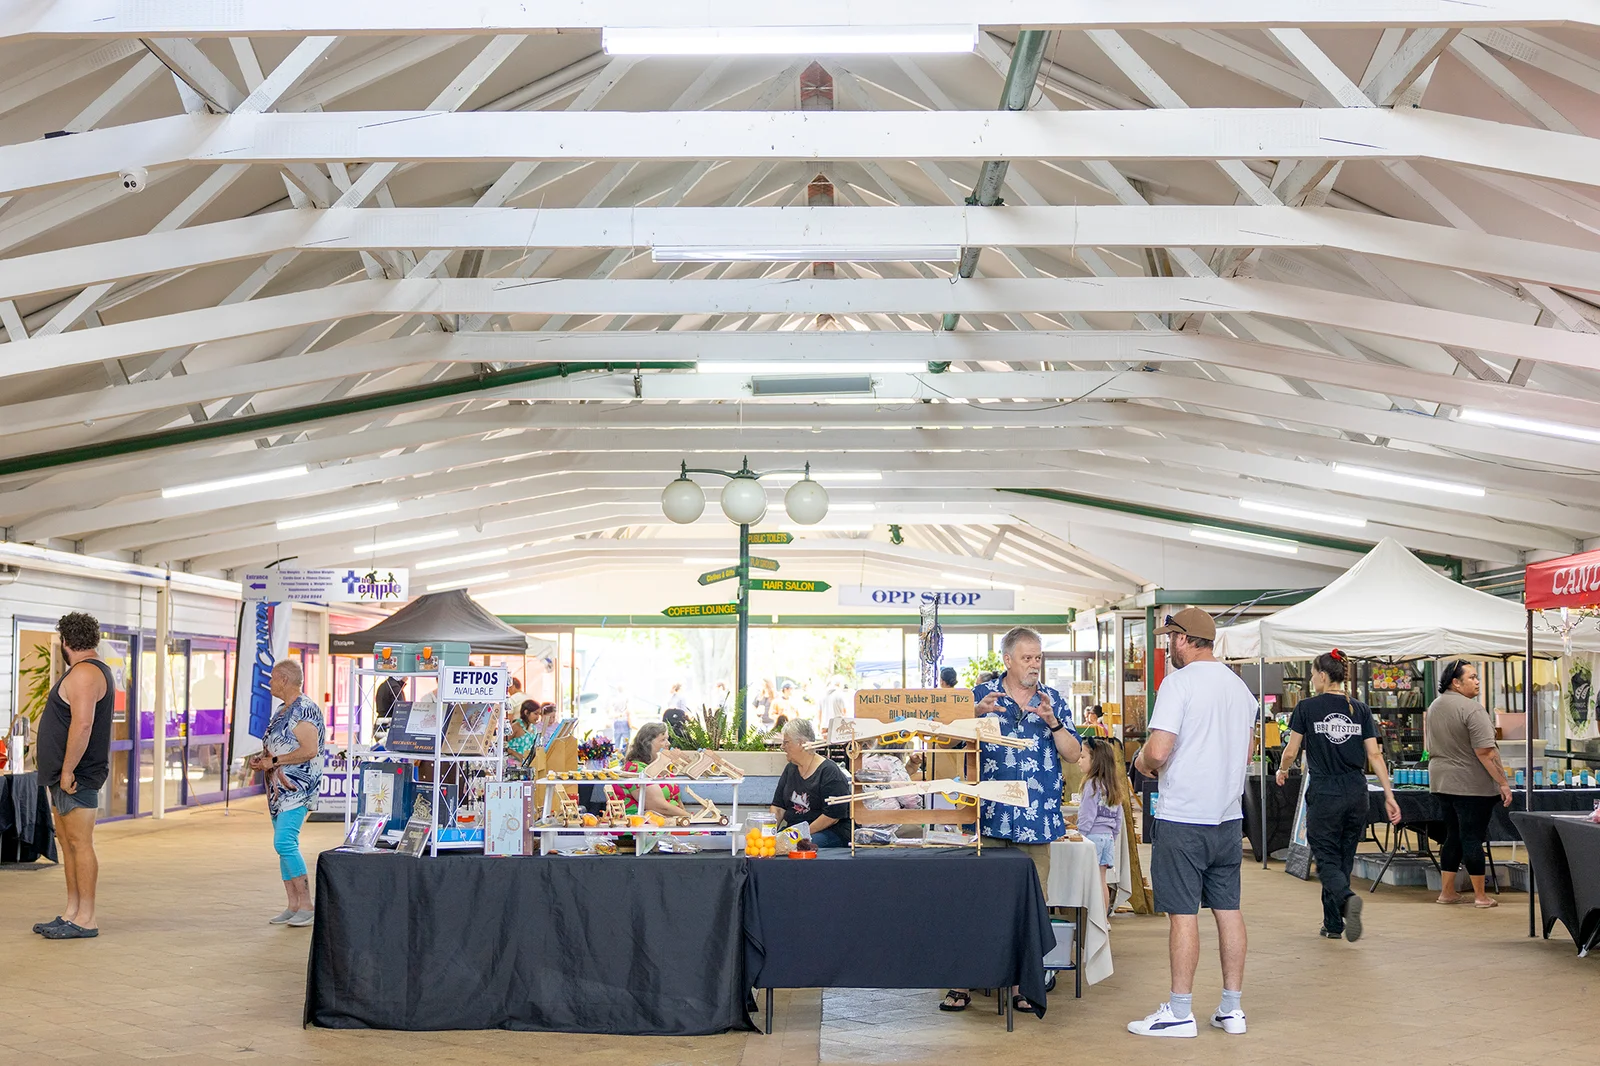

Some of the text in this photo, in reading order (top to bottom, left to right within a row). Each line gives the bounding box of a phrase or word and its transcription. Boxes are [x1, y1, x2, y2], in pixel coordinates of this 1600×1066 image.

[748, 533, 787, 543] PUBLIC TOILETS
[762, 581, 814, 591] HAIR SALON
[872, 590, 981, 606] OPP SHOP
[667, 604, 736, 616] COFFEE LOUNGE
[453, 671, 498, 685] EFTPOS
[454, 687, 494, 696] AVAILABLE
[905, 694, 928, 704] Rubber
[930, 694, 947, 703] Band
[919, 709, 940, 719] Made
[1331, 724, 1360, 733] PITSTOP
